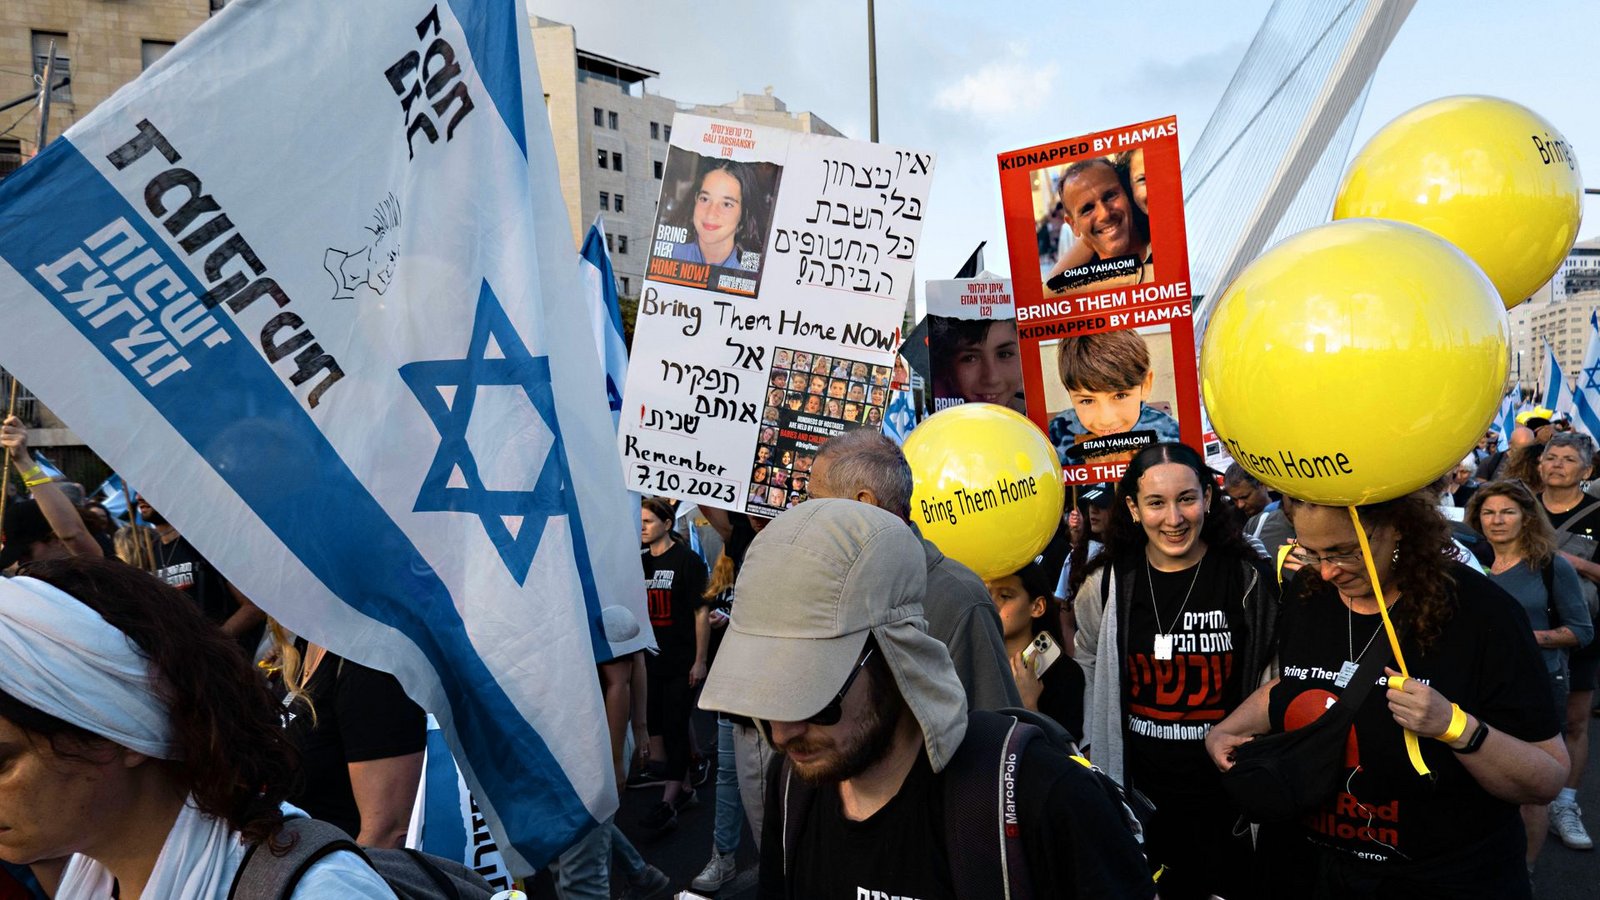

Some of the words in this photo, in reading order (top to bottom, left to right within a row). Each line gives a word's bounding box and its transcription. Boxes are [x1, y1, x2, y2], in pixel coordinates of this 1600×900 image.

[703, 133, 717, 143] GALI
[717, 135, 756, 150] TARSHANSKY
[721, 146, 733, 158] (13)
[1000, 142, 1089, 171] KIDNAPPED
[1093, 136, 1114, 152] BY
[1118, 122, 1177, 147] HAMAS
[822, 159, 891, 196] ניצחון
[895, 151, 931, 179] אין
[806, 200, 884, 231] השבת
[880, 188, 922, 221] בלי
[653, 241, 674, 258] HER
[656, 224, 688, 244] BRING
[774, 228, 880, 265] החטופים
[884, 227, 915, 259] כל
[650, 258, 680, 277] HOME
[680, 264, 711, 282] NOW!
[795, 255, 894, 296] הביתה!
[1063, 266, 1089, 279] OHAD
[1090, 259, 1135, 274] YAHALOMI
[960, 295, 978, 305] EITAN
[979, 294, 1011, 305] YAHALOMI
[980, 306, 993, 317] (12)
[1016, 299, 1071, 322] BRING
[1075, 290, 1131, 313] THEM
[1132, 282, 1188, 305] HOME
[641, 287, 701, 337] Bring
[714, 300, 772, 331] Them
[778, 310, 837, 341] Home
[841, 323, 901, 354] NOW!
[1019, 317, 1106, 340] KIDNAPPED
[1109, 312, 1130, 328] BY
[1134, 304, 1192, 323] HAMAS
[725, 338, 765, 370] אל
[661, 359, 740, 396] תפקירו
[639, 403, 700, 435] שנית!
[694, 394, 758, 424] אותם
[624, 434, 727, 477] Remember
[1083, 440, 1105, 451] EITAN
[1106, 435, 1151, 448] YAHALOMI
[1228, 438, 1282, 477] Them
[1279, 451, 1353, 479] Home
[636, 464, 736, 503] 7.10.2023
[1092, 463, 1131, 480] THE
[921, 496, 957, 525] Bring
[954, 488, 998, 516] Them
[998, 476, 1038, 505] Home
[1172, 633, 1197, 653] הבי
[1200, 632, 1234, 653] אותם
[1284, 665, 1309, 680] Bring
[1004, 753, 1018, 824] MarcoPolo
[1336, 790, 1400, 823] Red
[1352, 850, 1389, 862] error
